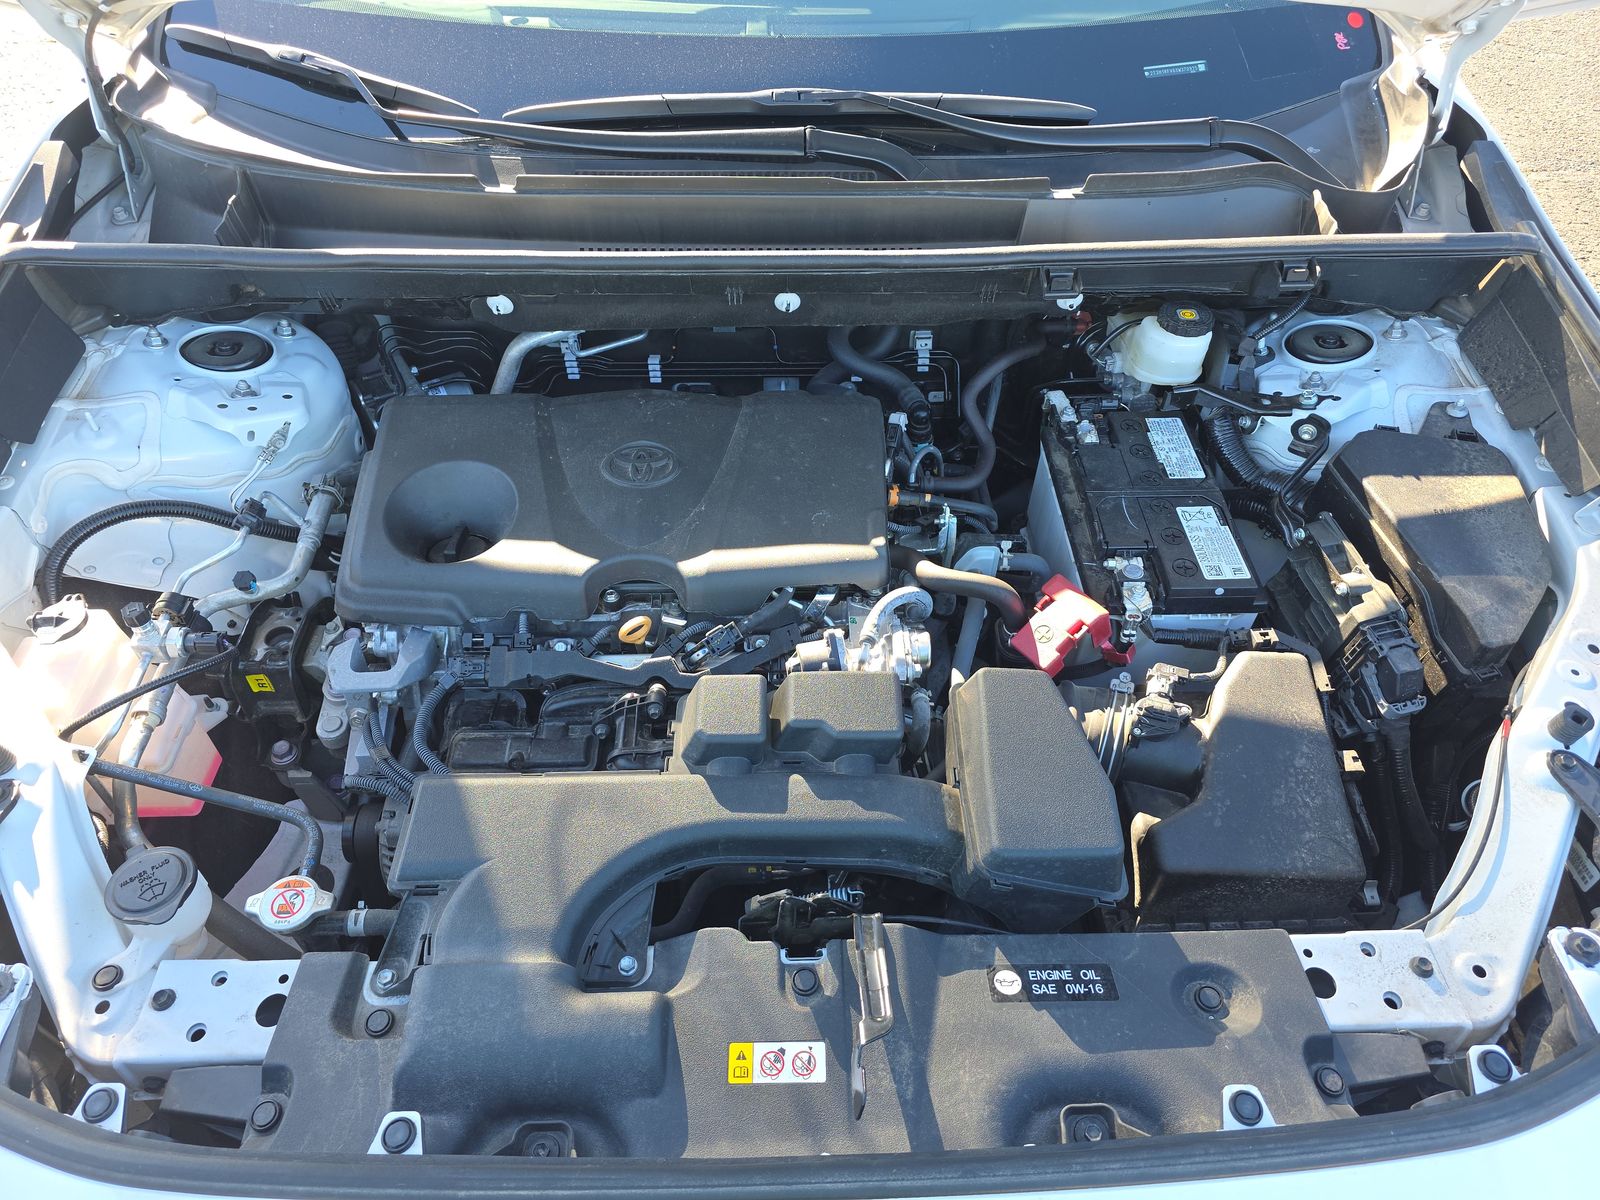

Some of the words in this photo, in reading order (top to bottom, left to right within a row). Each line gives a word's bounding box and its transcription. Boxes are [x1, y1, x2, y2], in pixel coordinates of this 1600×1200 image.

[254, 678, 268, 688] R1
[151, 858, 170, 871] FLUID
[137, 872, 155, 884] ONLY
[1028, 969, 1073, 980] ENGINE
[1080, 969, 1101, 980] OIL
[1032, 984, 1058, 995] SAE
[1065, 983, 1104, 994] 0W-16
